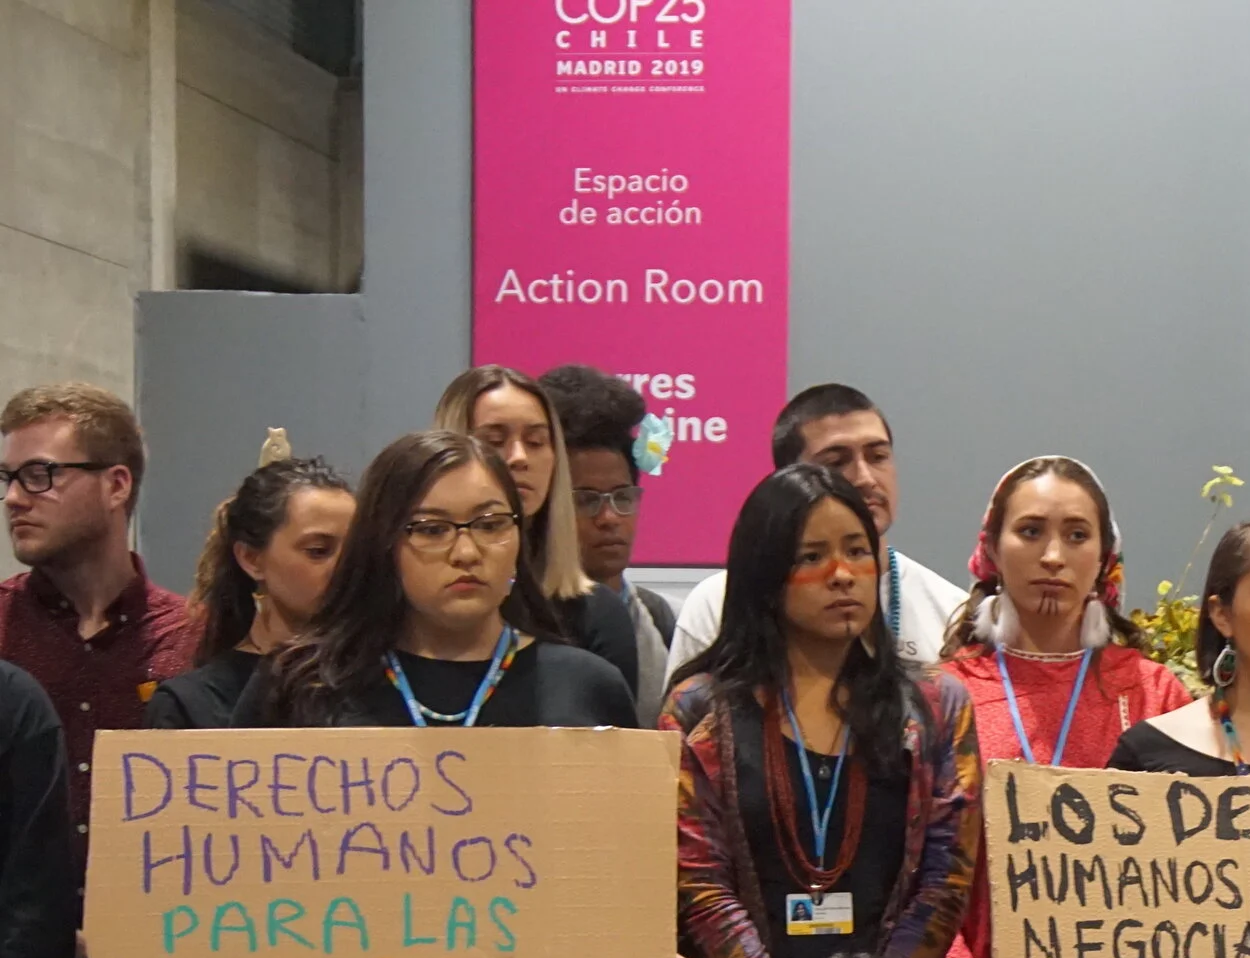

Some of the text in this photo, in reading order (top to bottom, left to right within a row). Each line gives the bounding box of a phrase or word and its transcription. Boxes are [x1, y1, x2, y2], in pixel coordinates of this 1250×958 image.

[555, 0, 706, 24] COP25
[555, 30, 704, 48] CHILE
[556, 60, 704, 75] MADRID 2019
[574, 168, 688, 199] Espacio
[559, 199, 702, 225] de acción
[495, 269, 763, 303] Action Room
[664, 407, 728, 442] ine
[122, 750, 473, 821] DERECHOS
[1006, 772, 1147, 845] LOS
[143, 822, 537, 895] HUMANOS
[1007, 849, 1244, 912] HUMANOS
[161, 893, 519, 954] PARA LAS
